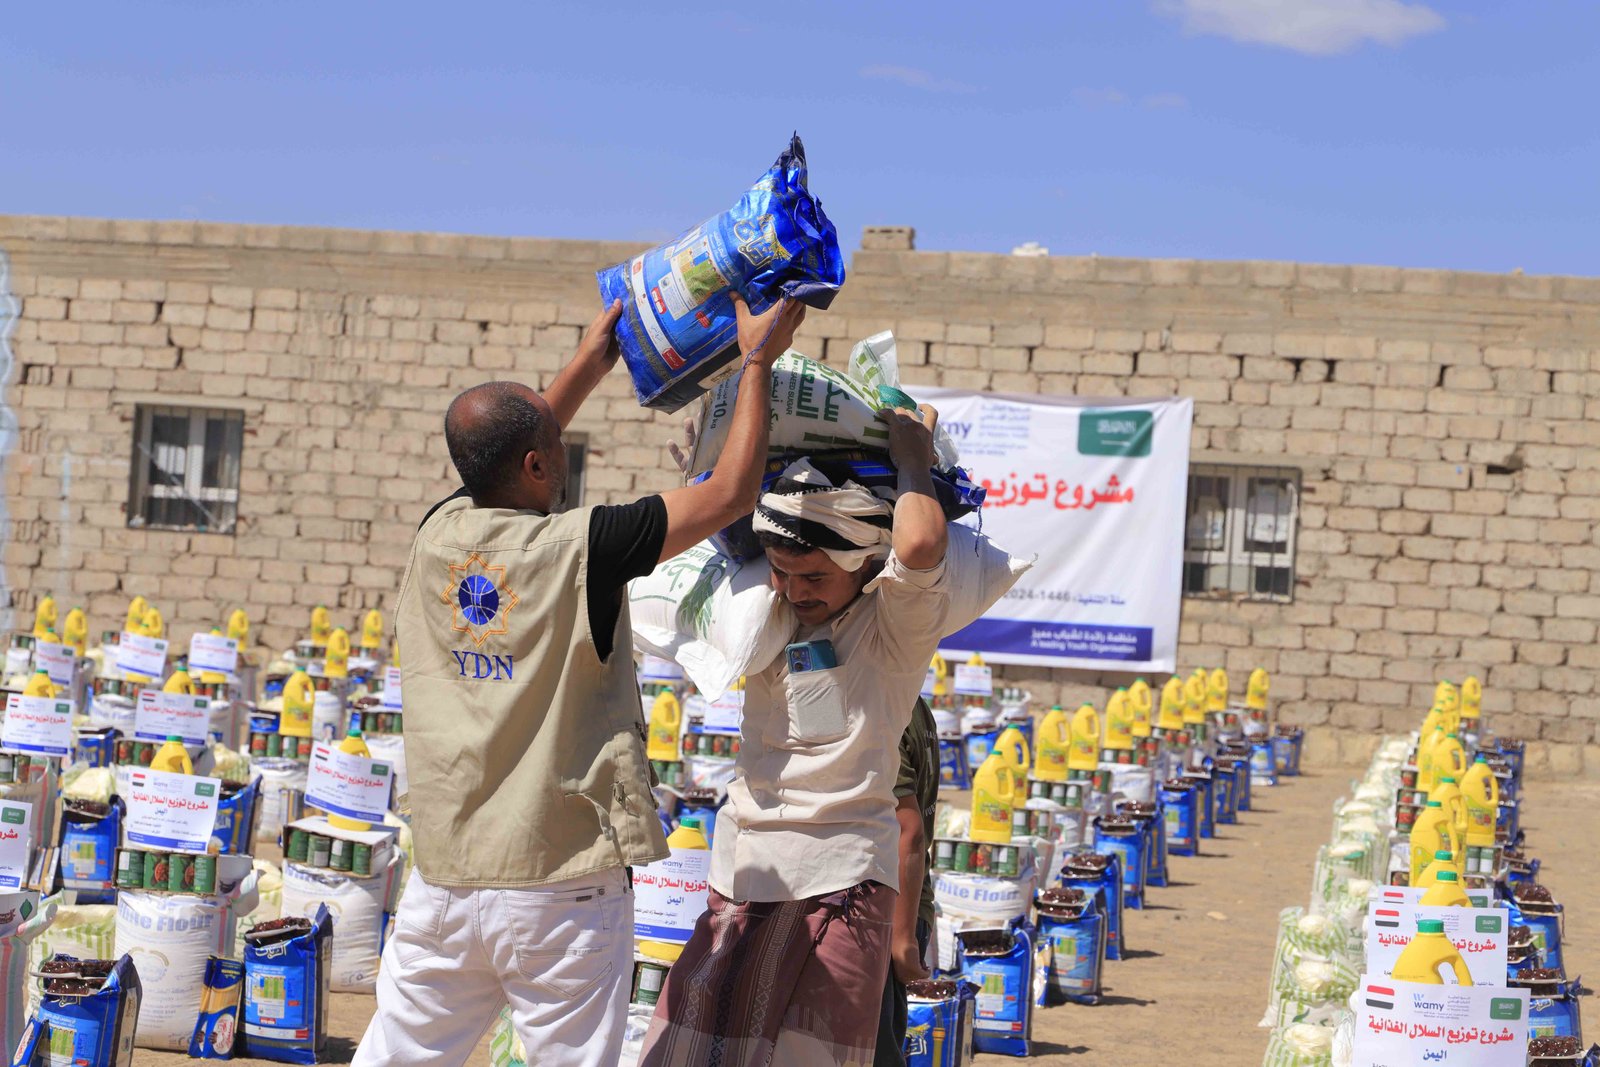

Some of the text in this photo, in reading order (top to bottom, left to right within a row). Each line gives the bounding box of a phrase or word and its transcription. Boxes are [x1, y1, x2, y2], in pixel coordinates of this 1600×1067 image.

[785, 390, 795, 415] SUGAR
[820, 374, 850, 422] سكر
[713, 400, 727, 418] 10
[944, 418, 972, 439] my
[982, 472, 1135, 510] مشروع توزيع
[452, 650, 514, 680] YDN
[168, 797, 187, 808] توزيع
[187, 800, 209, 810] مشروع
[0, 827, 18, 839] مشرو
[662, 859, 683, 867] wamy
[658, 876, 683, 888] السلال
[684, 879, 708, 892] توزيع
[667, 896, 684, 905] اليمن
[157, 913, 214, 931] Flour
[1467, 938, 1496, 953] مشروع
[1414, 1001, 1445, 1012] wamy
[1368, 1014, 1407, 1033] الغذائية
[1409, 1023, 1445, 1039] السلال
[1447, 1026, 1478, 1044] توزيع
[1479, 1027, 1514, 1044] مشروع
[1423, 1049, 1447, 1062] اليمن
